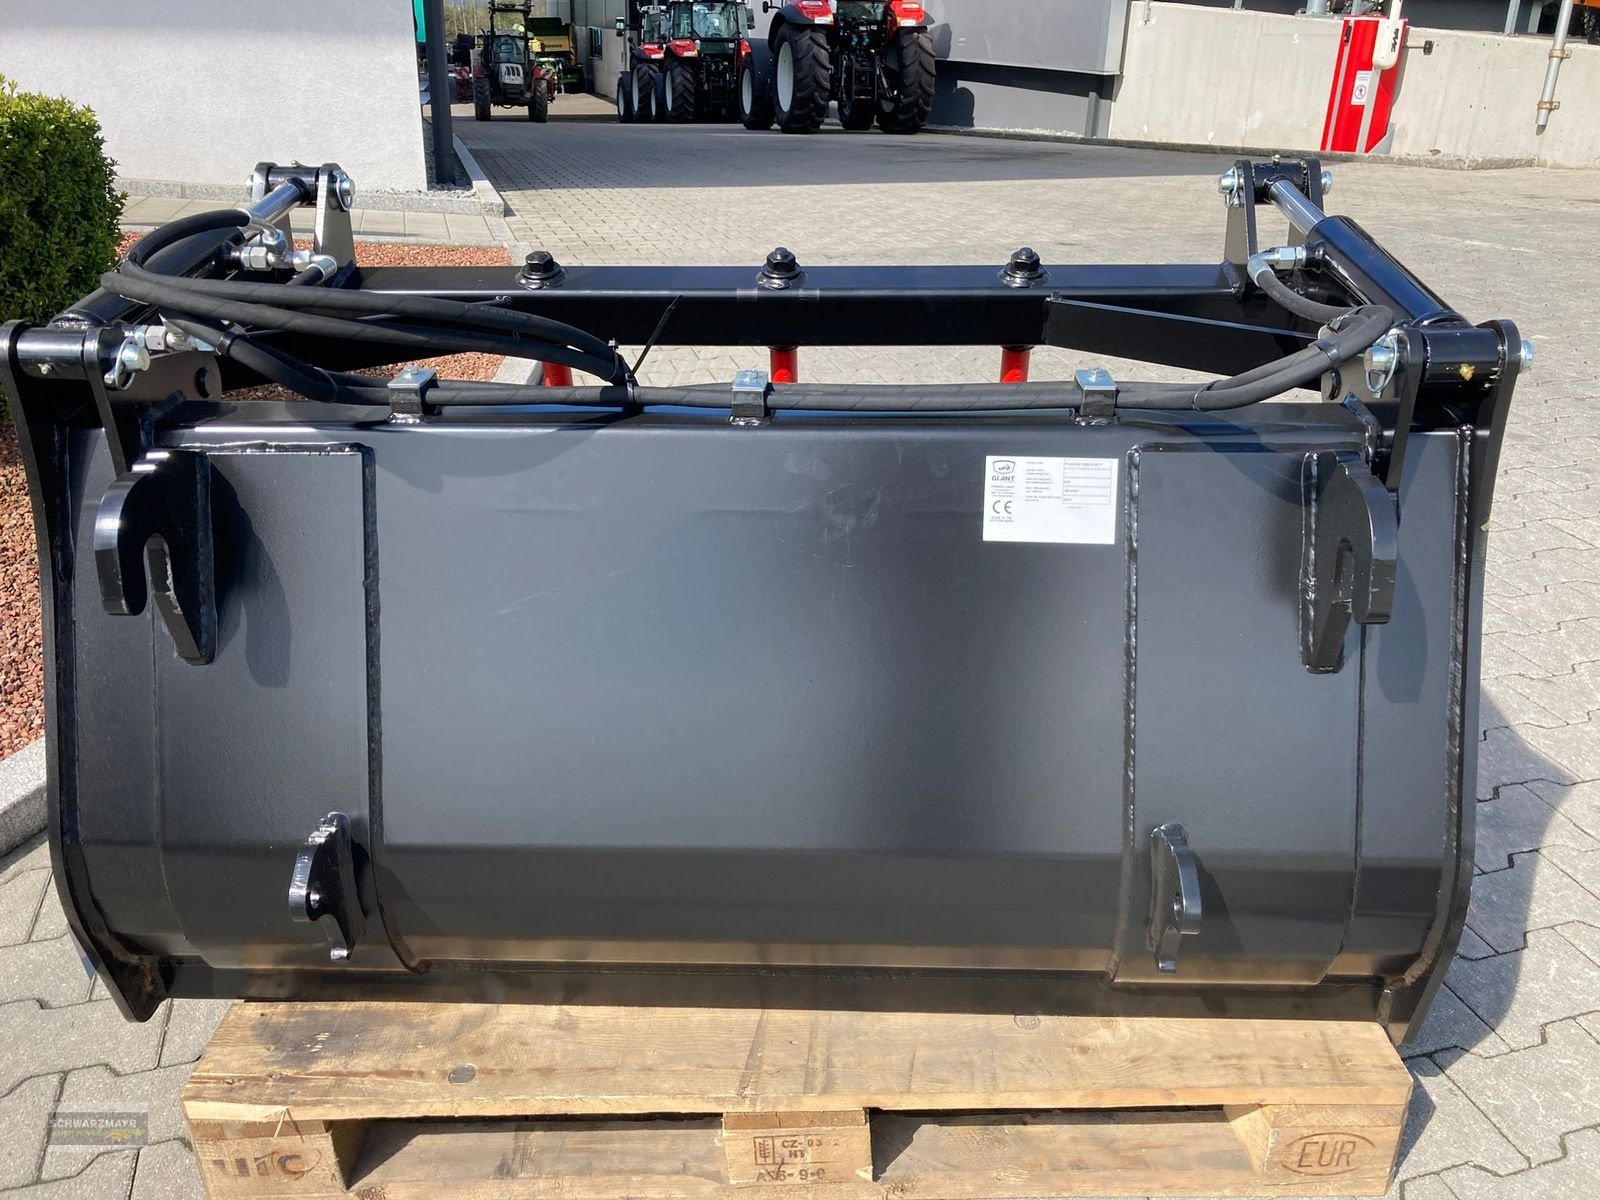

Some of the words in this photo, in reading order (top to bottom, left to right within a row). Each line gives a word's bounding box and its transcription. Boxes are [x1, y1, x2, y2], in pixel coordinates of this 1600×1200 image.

[991, 475, 1016, 483] GIANT
[992, 500, 1012, 515] CE
[788, 1149, 806, 1159] HT
[1297, 1140, 1357, 1168] EUR
